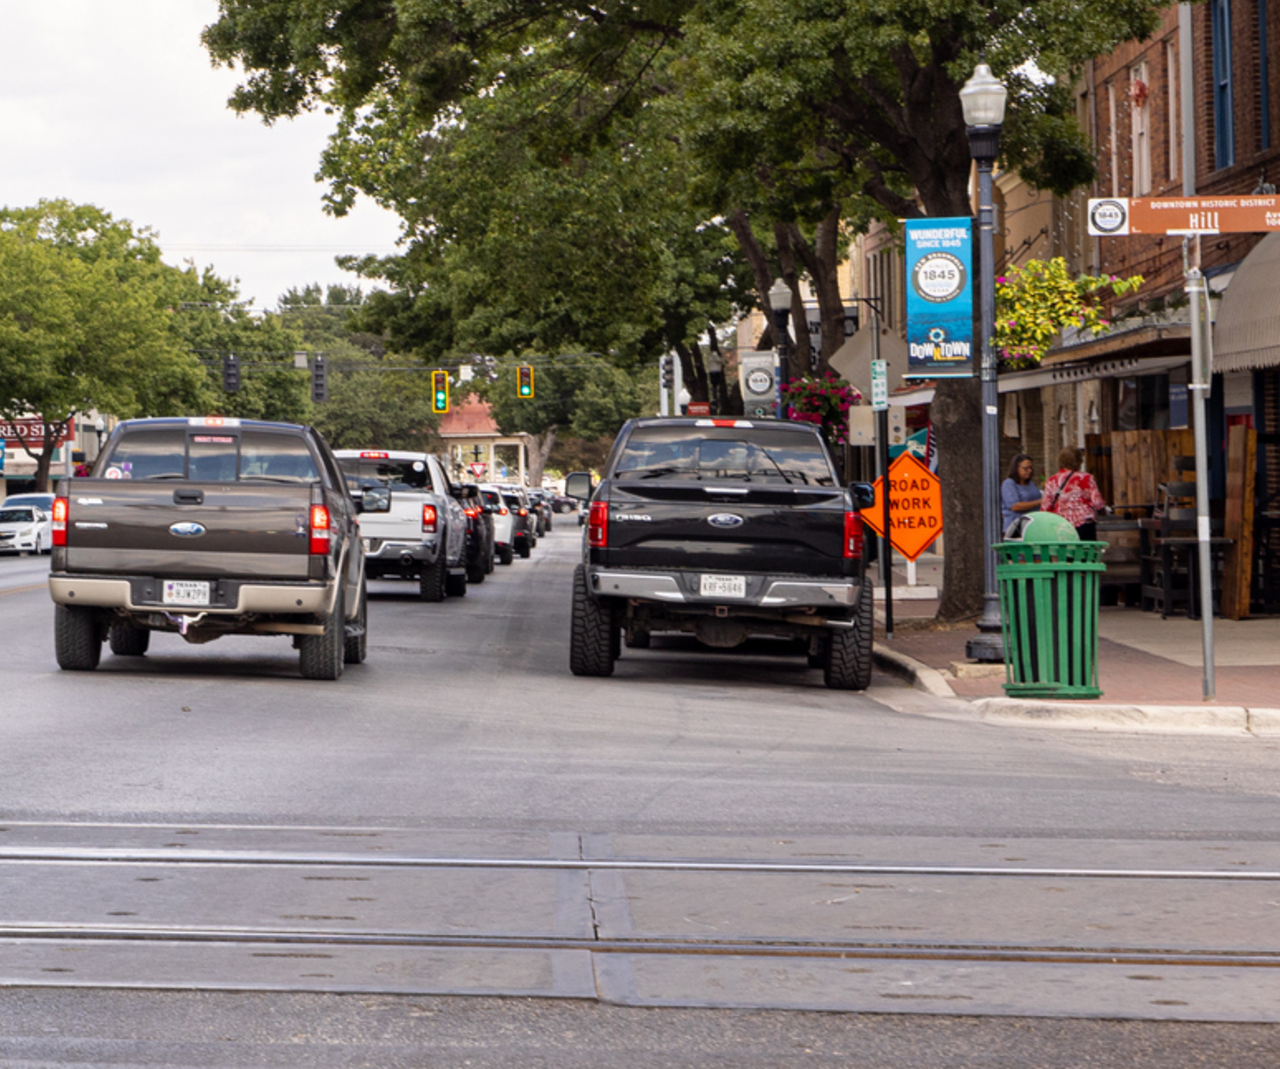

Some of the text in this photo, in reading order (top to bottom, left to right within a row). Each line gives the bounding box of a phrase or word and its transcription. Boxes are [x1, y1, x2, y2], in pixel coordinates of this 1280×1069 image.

[1150, 198, 1276, 209] DOWNTOWN HISTORIC DISTRICT
[1190, 211, 1220, 229] Hill
[909, 228, 968, 240] WUNDERFUL
[916, 238, 961, 248] SINCE 1845
[923, 270, 955, 280] 1845
[910, 341, 970, 361] DOWNTOWN
[890, 478, 930, 492] ROAD
[889, 497, 931, 510] WORK
[889, 516, 938, 529] AHEAD
